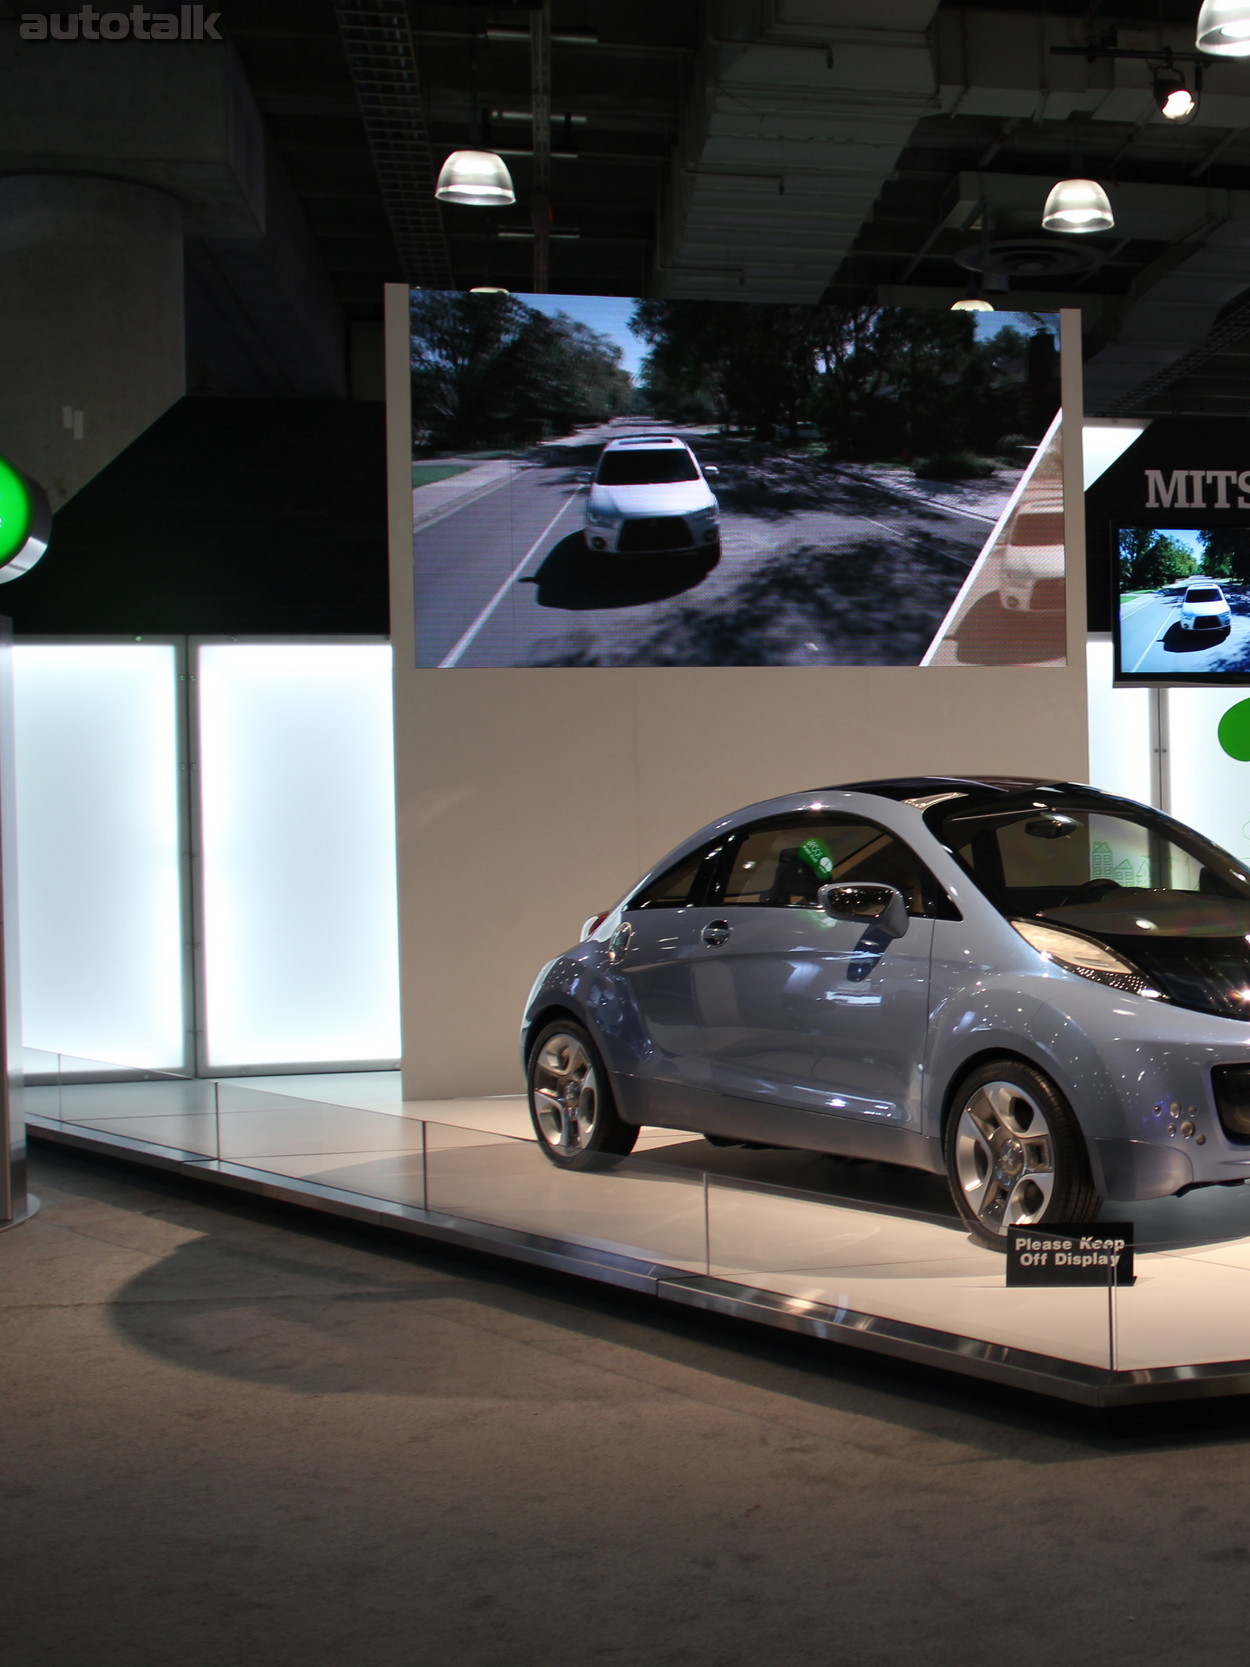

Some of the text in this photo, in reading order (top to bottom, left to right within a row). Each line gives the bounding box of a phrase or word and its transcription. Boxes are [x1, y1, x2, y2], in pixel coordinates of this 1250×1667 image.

[1015, 1236, 1126, 1252] Please Keep
[1020, 1251, 1121, 1268] Off Display
